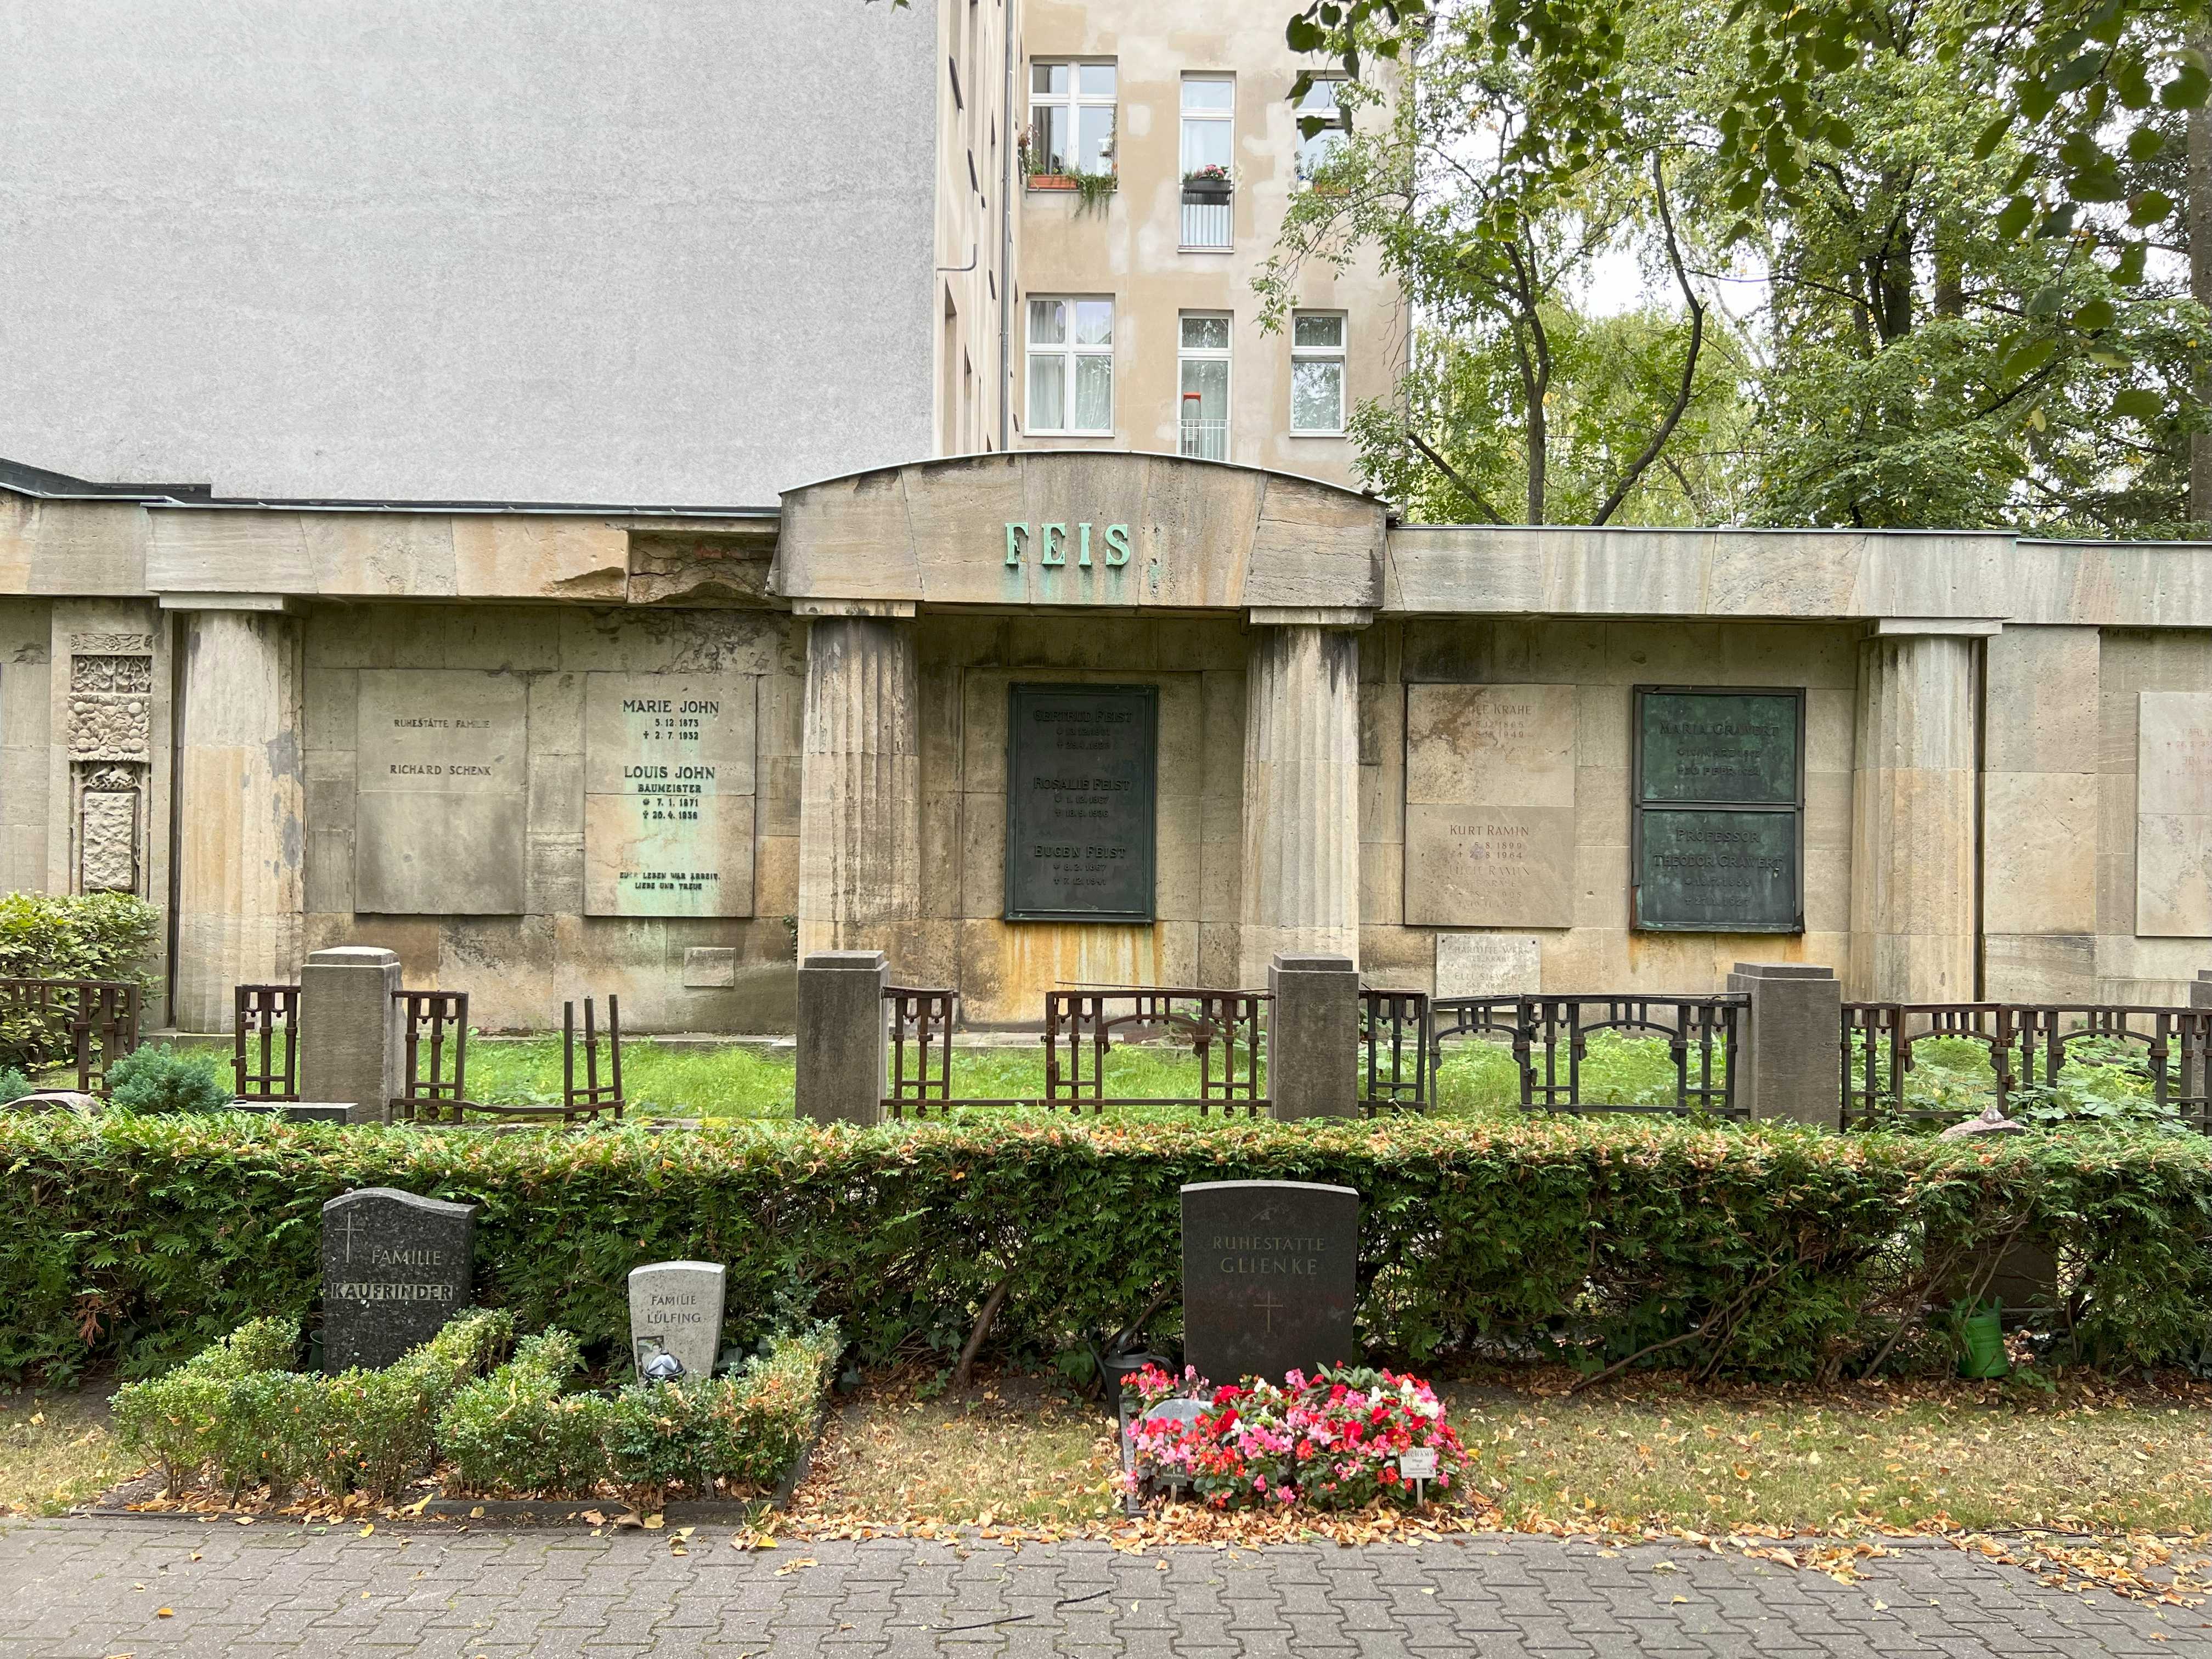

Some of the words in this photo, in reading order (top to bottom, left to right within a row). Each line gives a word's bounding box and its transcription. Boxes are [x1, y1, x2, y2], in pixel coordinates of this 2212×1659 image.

[1005, 522, 1130, 566] FEIS
[623, 699, 672, 712] MARIE
[680, 701, 719, 713] JOHN
[1494, 704, 1532, 714] KRAHE
[394, 718, 449, 728] RUHESTÄTTE
[1033, 710, 1092, 722] GERTRUD
[1096, 710, 1132, 723] FEIST
[1660, 722, 1707, 735] MARIA
[1713, 724, 1780, 736] GRAWERT
[390, 765, 442, 774] RICHARD
[449, 766, 492, 776] SCHENK
[624, 766, 668, 778] LOUIS
[675, 766, 715, 779] JOHN
[637, 783, 702, 793] BAUMEISTER
[1033, 776, 1090, 789] ROSALIE
[1093, 778, 1132, 791] FEIST
[680, 798, 698, 807] 1871
[1450, 825, 1483, 836] KURT
[1487, 825, 1529, 836] RAMIN
[1676, 828, 1760, 843] PROFESSOR
[1035, 844, 1081, 857] EUGEN
[1086, 845, 1126, 858] FEIST
[1655, 854, 1716, 867] THEODOR
[1718, 855, 1782, 868] GRAWERT
[1213, 1237, 1325, 1251] RUHESTÄTTE
[371, 1250, 441, 1265] FAMILIE
[1220, 1257, 1317, 1275] GLIENKE
[331, 1283, 453, 1301] KAUFRINDER
[652, 1295, 697, 1306] FAMILIE
[647, 1310, 701, 1324] LÜLFING
